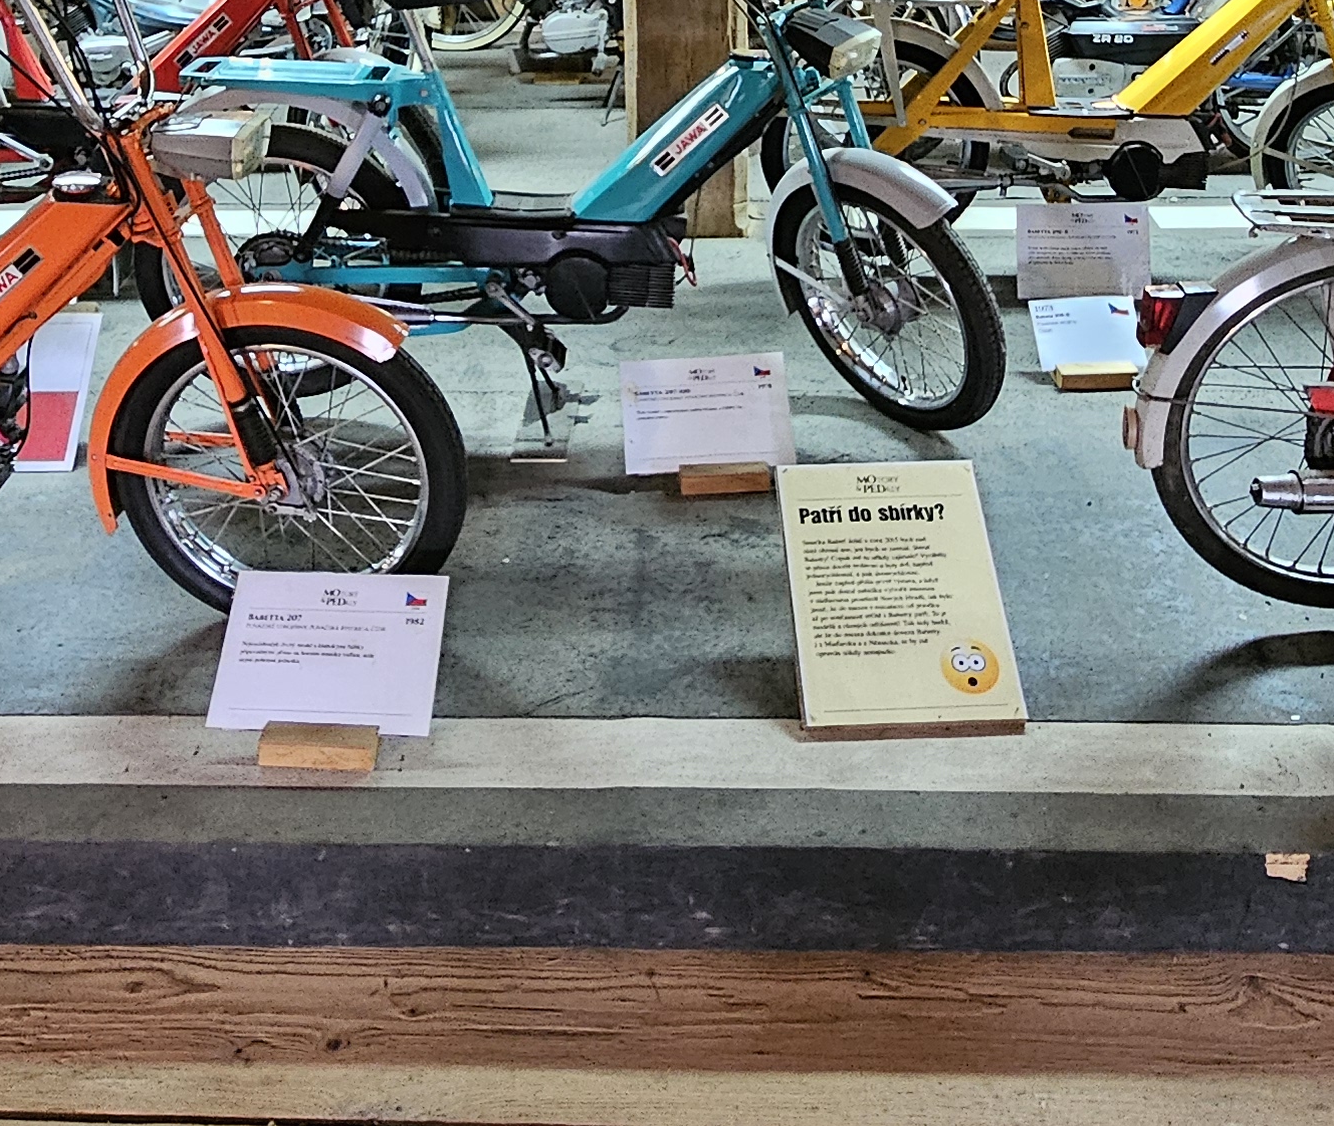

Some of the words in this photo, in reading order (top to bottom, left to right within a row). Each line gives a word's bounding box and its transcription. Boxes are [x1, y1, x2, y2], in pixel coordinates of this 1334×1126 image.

[192, 30, 216, 54] JAWA
[675, 123, 708, 155] JAWA
[798, 505, 842, 524] Patří
[848, 506, 872, 522] do
[878, 503, 945, 522] sbírky?
